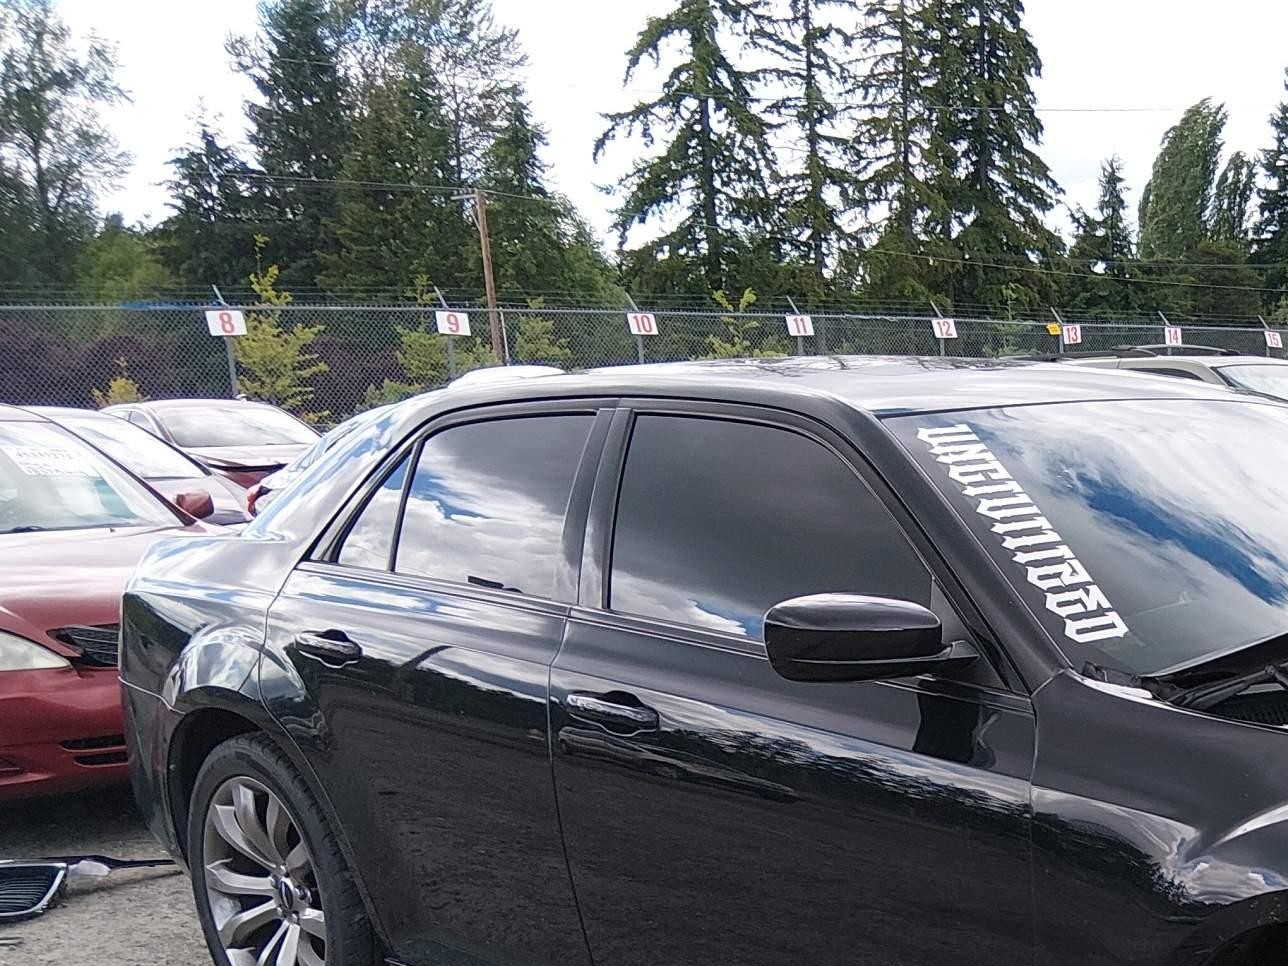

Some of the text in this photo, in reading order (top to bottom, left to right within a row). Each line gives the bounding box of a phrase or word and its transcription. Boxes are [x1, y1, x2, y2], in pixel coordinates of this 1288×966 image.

[219, 312, 235, 334] 8
[446, 313, 460, 333] 9
[632, 314, 653, 334] 10
[793, 317, 808, 334] 11
[936, 320, 953, 337] 12
[1066, 326, 1079, 342] 13
[1167, 330, 1179, 345] 14
[1268, 333, 1280, 347] 15
